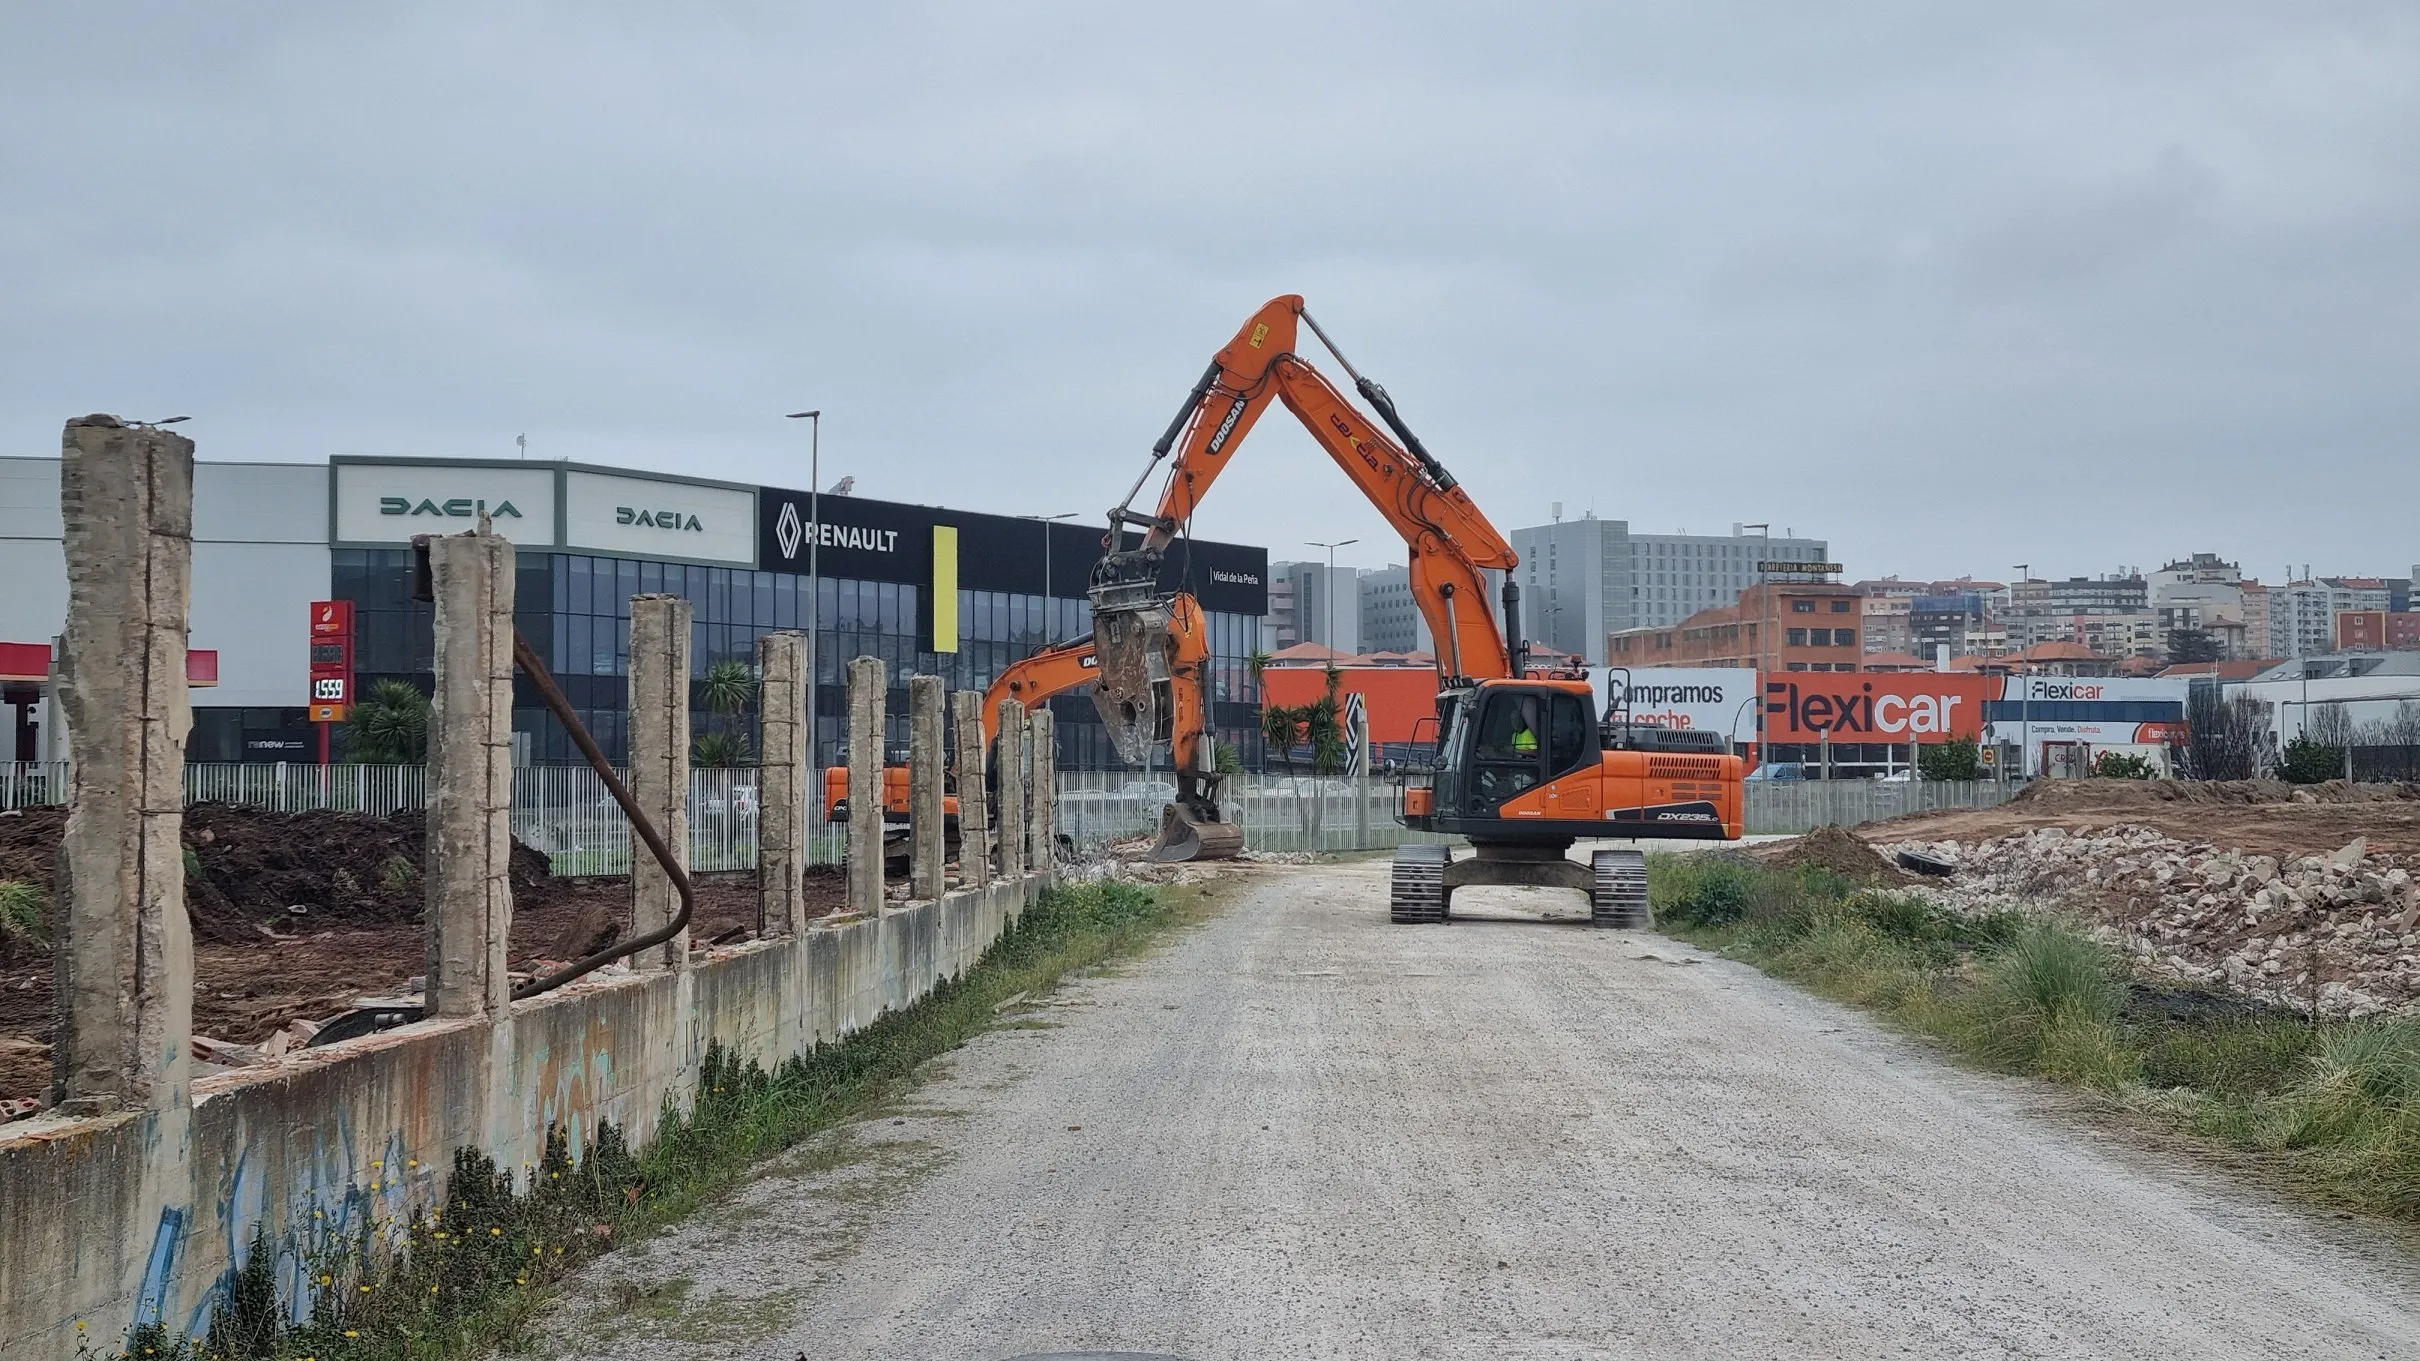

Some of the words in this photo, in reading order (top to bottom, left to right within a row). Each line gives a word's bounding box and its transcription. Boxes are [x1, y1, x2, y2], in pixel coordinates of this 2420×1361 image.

[1210, 400, 1245, 452] DOOSAN
[380, 497, 522, 518] DACIA
[616, 506, 703, 532] DACIA
[804, 521, 899, 553] RENAULT
[1213, 570, 1229, 582] Vidal
[1229, 572, 1237, 583] de
[1237, 572, 1243, 584] la
[1243, 573, 1259, 585] Peña
[1611, 679, 1724, 709] Compramos
[2032, 680, 2104, 700] Flexicar
[1757, 682, 1962, 734] Flexicar
